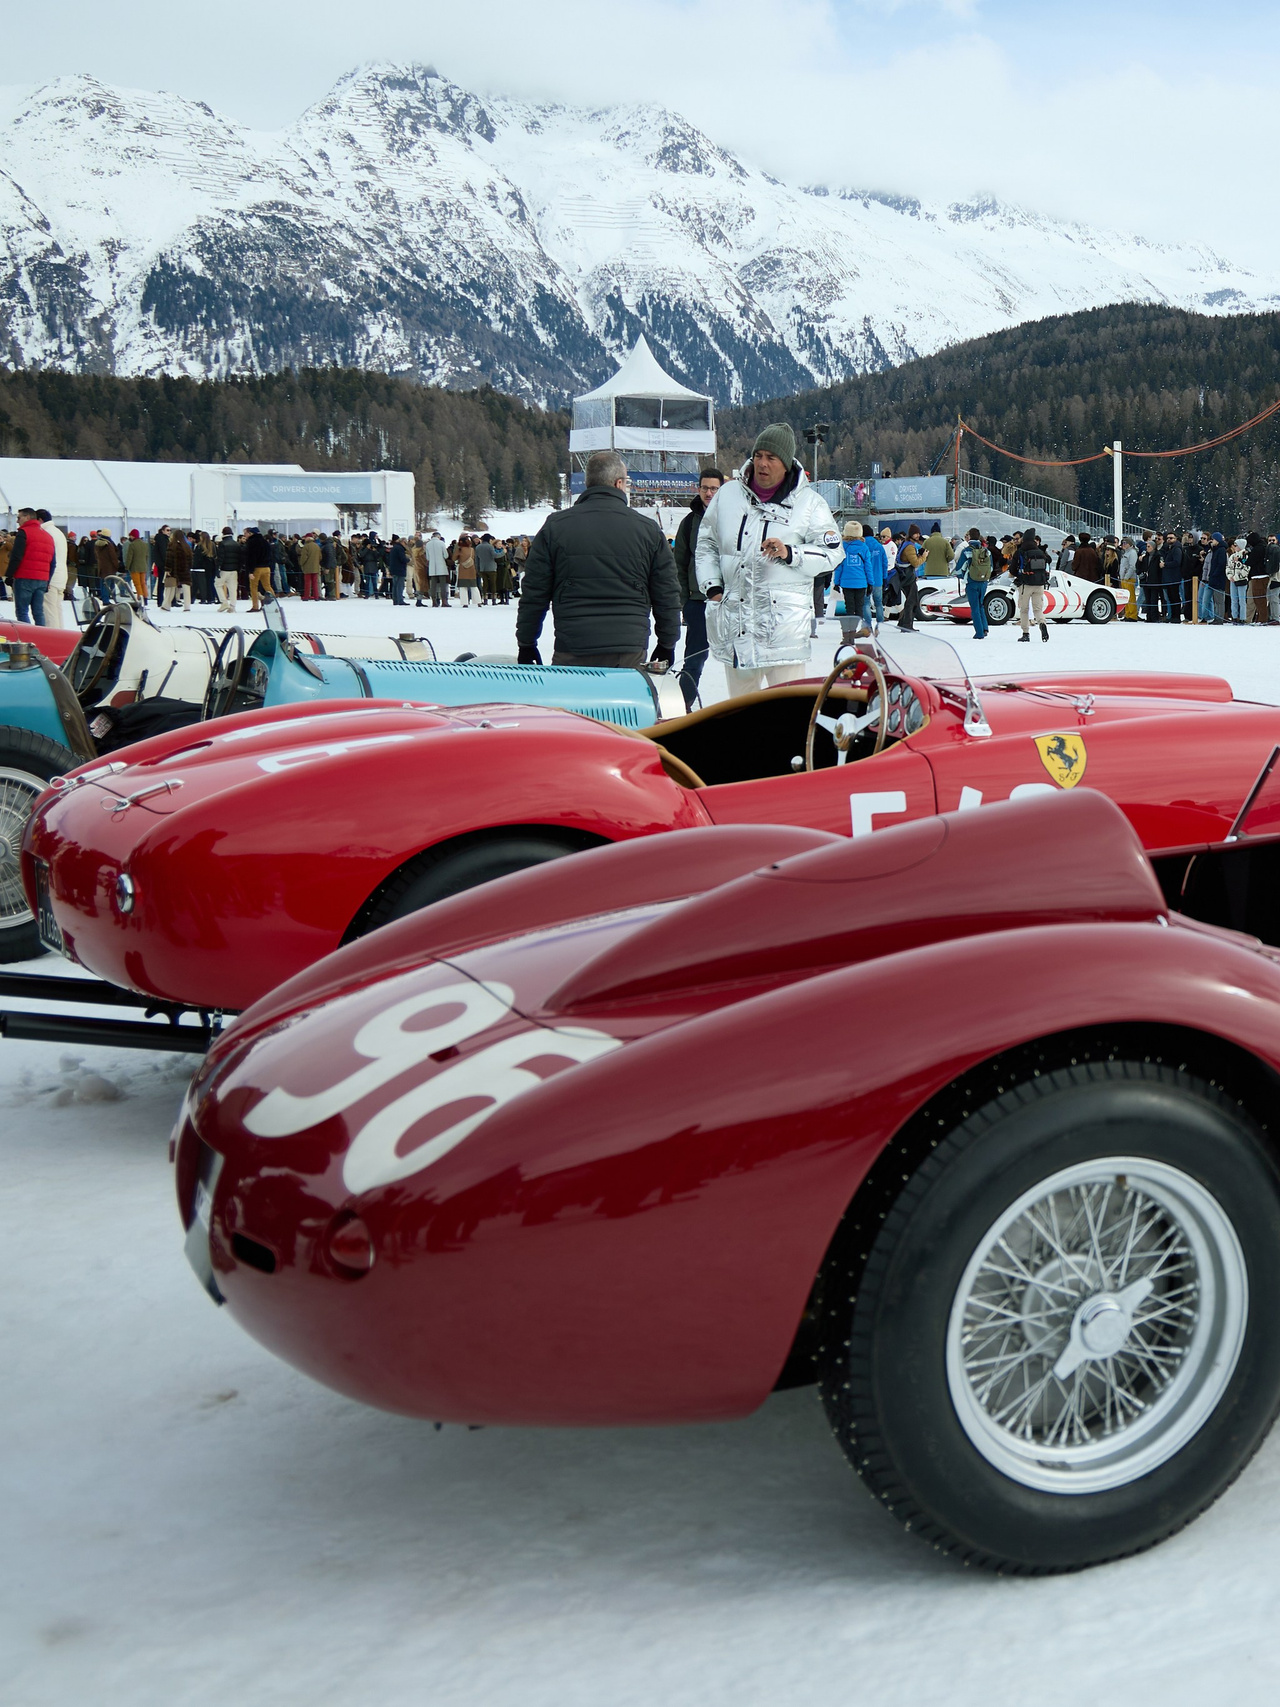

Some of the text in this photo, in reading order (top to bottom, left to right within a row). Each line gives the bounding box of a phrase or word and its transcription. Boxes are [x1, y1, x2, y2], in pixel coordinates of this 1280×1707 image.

[874, 464, 880, 474] A1
[900, 494, 922, 502] SPONSORS
[242, 981, 623, 1195] 96
